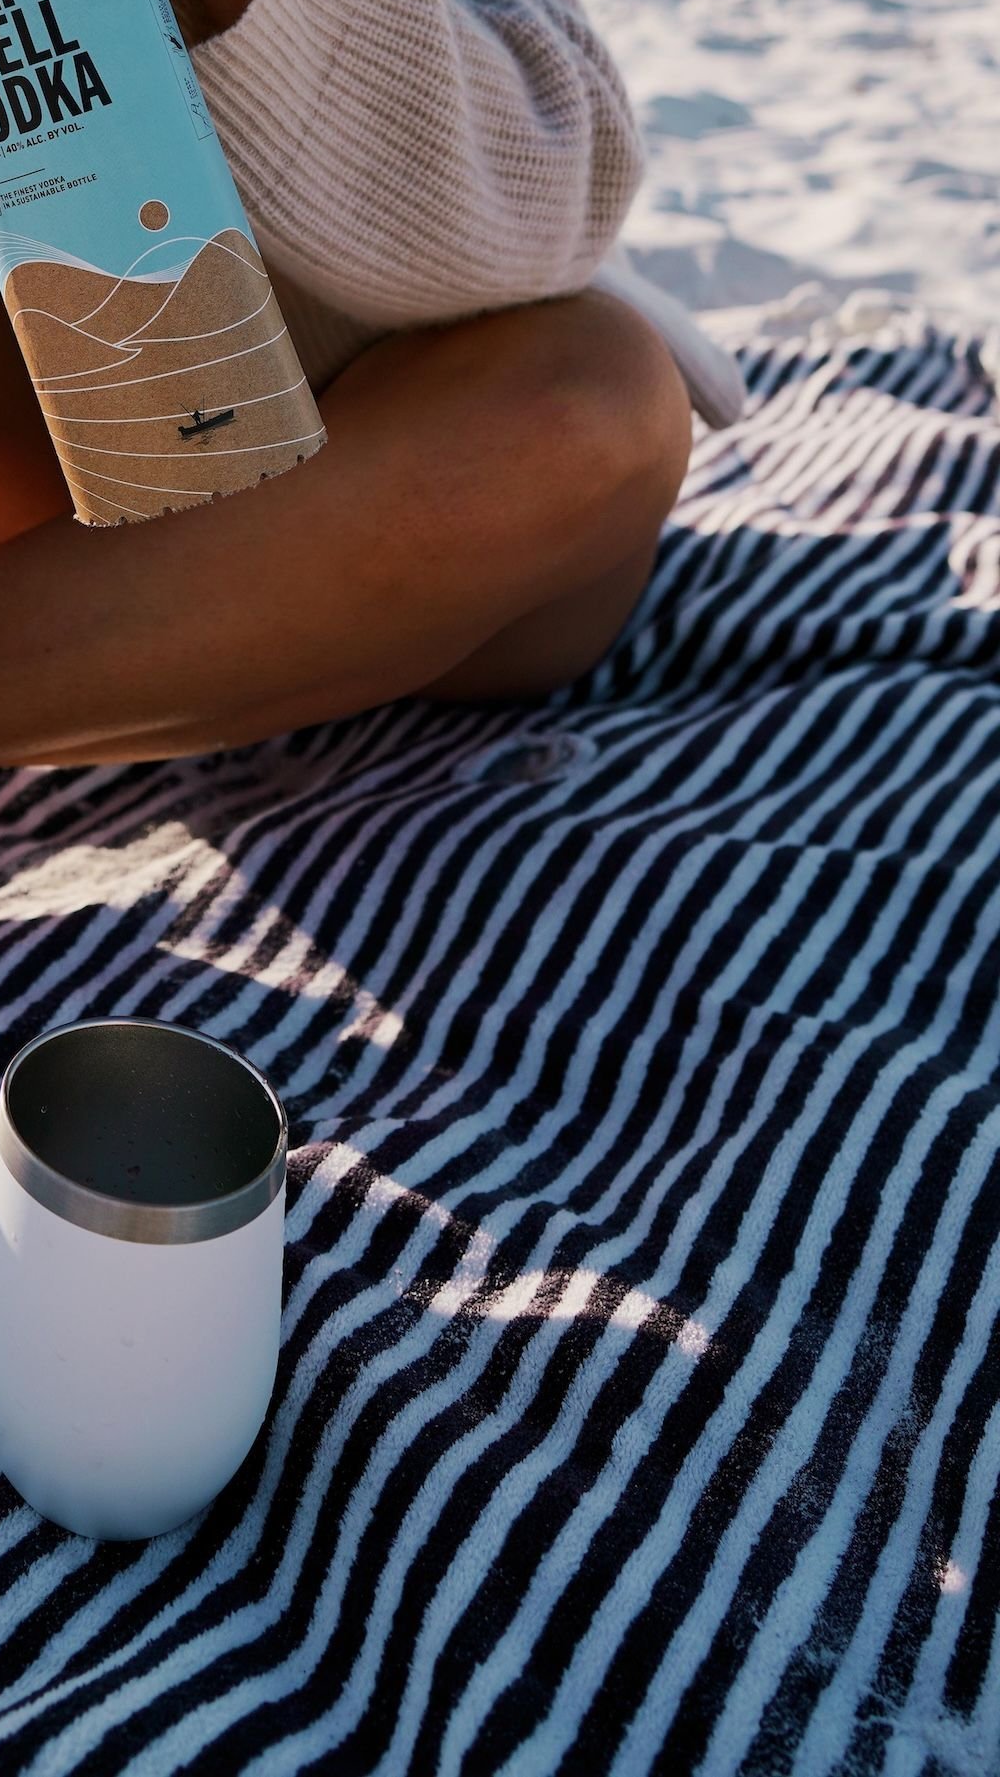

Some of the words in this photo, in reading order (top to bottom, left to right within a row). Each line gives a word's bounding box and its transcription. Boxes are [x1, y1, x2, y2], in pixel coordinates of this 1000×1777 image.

[6, 141, 25, 154] 40%
[26, 134, 46, 147] ALC.
[47, 129, 60, 140] BY
[61, 122, 84, 135] VOL.
[0, 192, 13, 201] THE
[13, 184, 37, 197] FINEST
[38, 175, 66, 190] VODKA
[3, 202, 11, 210] IN
[16, 185, 66, 206] SUSTAINABLE
[67, 173, 97, 190] BOTTLE
